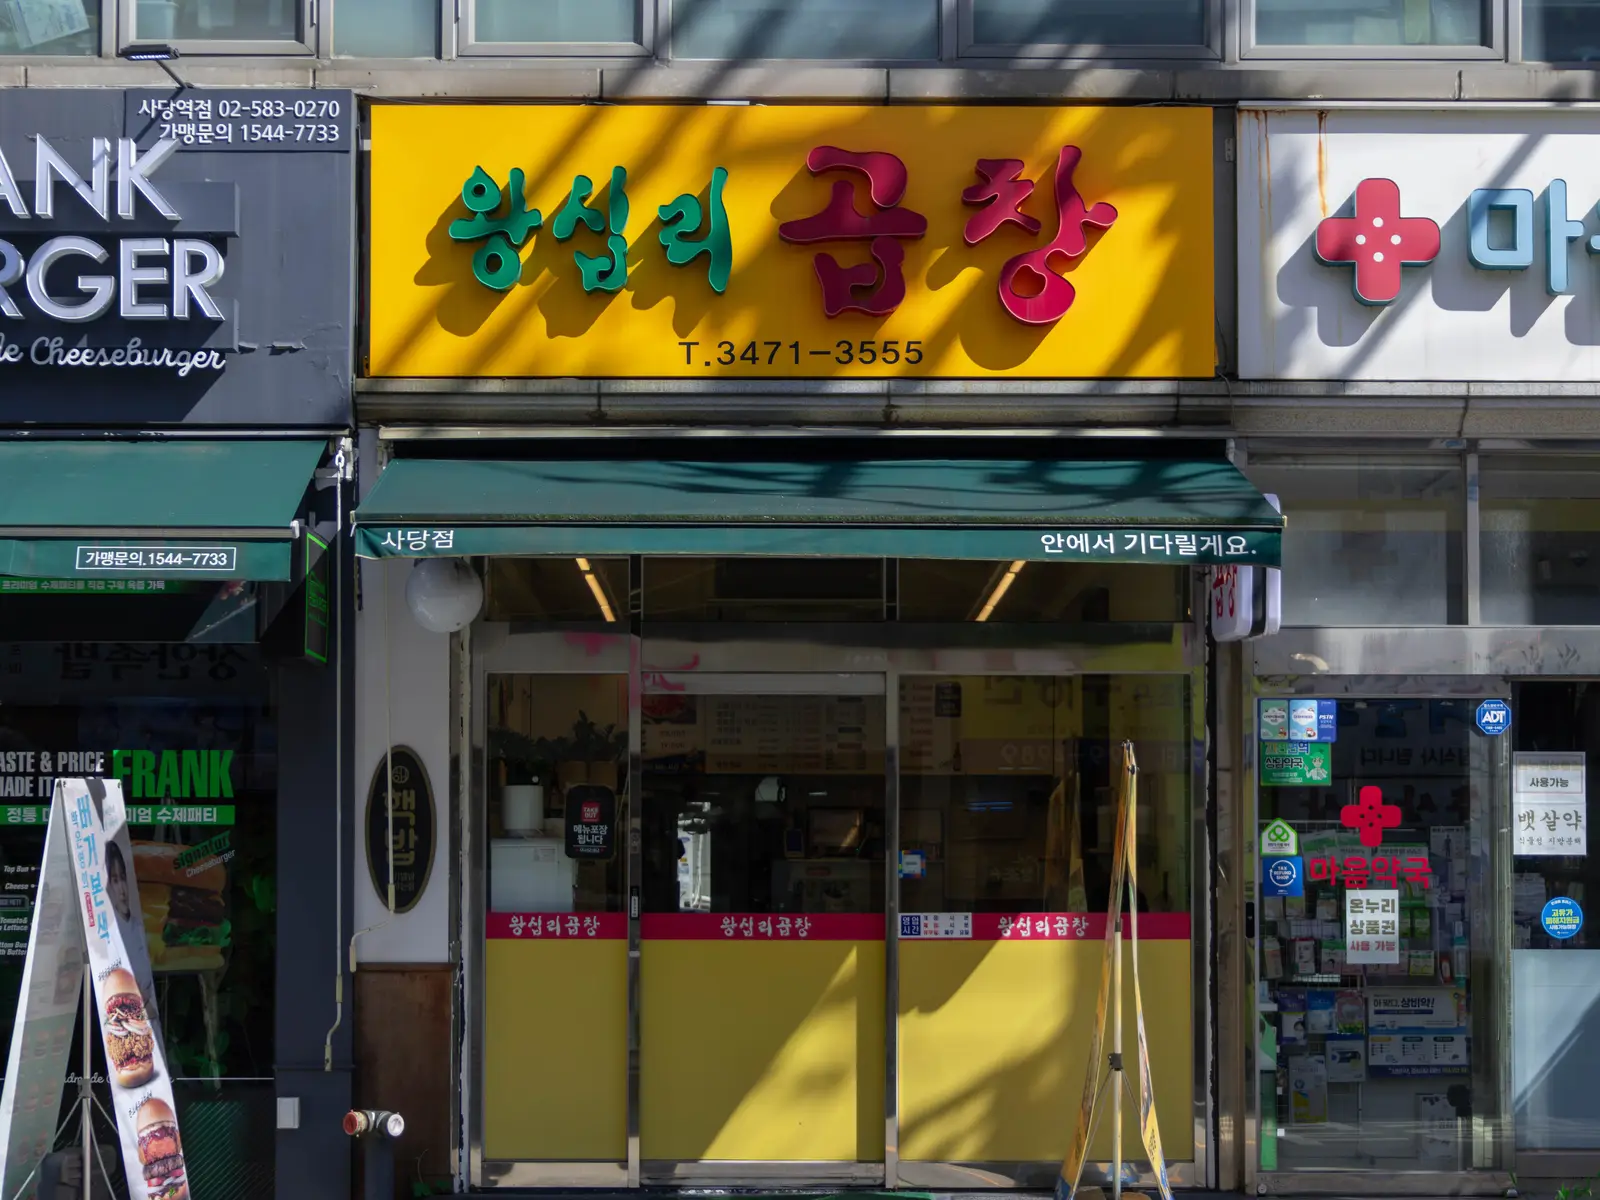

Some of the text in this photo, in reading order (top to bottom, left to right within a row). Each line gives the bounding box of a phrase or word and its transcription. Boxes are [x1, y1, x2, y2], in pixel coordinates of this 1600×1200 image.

[139, 99, 340, 120] 사당역점 02-583-0270
[160, 123, 339, 143] 가맹문의 1544-7733
[449, 145, 1118, 326] 왕십리 곱창
[1467, 178, 1600, 296] 마
[30, 337, 226, 377] Cheeseburger
[678, 341, 923, 367] T.3471-3555
[381, 529, 454, 551] 사당점
[1041, 533, 1257, 557] 안에서 기다릴게요.
[1481, 711, 1506, 723] ADT
[40, 751, 52, 773] &
[57, 751, 105, 773] PRICE
[113, 750, 234, 797] FRANK
[1529, 777, 1569, 788] 사용가능
[157, 807, 217, 823] 수제패티
[573, 824, 609, 835] 메뉴포장
[577, 834, 604, 845] 됩니다
[1310, 856, 1433, 888] 마음약국
[1350, 898, 1396, 913] 온누리
[1551, 909, 1574, 917] 고유가
[509, 915, 601, 937] 왕십리곱창
[720, 916, 812, 937] 왕십리곱창
[903, 916, 920, 925] 영업
[903, 926, 920, 935] 시간
[998, 916, 1090, 938] 왕십리곱창
[1350, 920, 1396, 935] 상품권
[1350, 940, 1396, 952] 사용 가능
